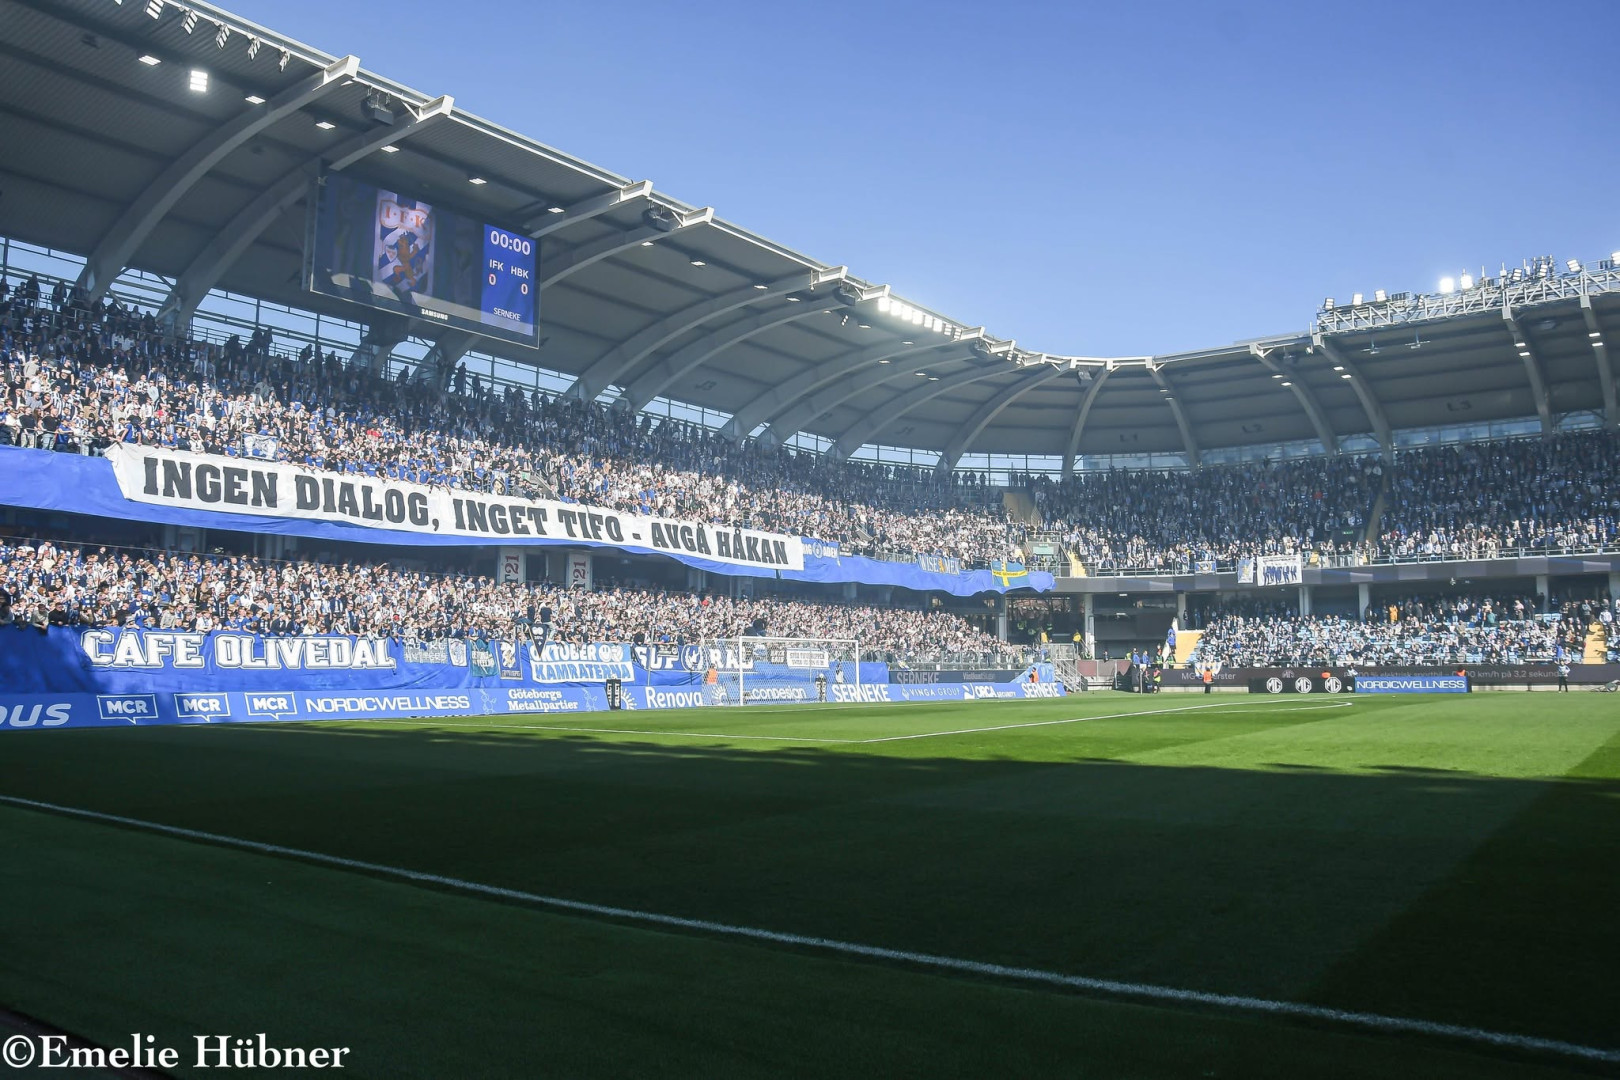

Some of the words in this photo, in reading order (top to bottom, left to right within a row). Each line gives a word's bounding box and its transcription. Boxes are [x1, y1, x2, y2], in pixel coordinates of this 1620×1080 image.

[490, 230, 531, 256] 00:00
[489, 258, 504, 272] IFK
[510, 265, 529, 280] HBK
[488, 273, 497, 286] 0
[520, 283, 529, 295] 0
[421, 308, 449, 321] SAMSUNG
[493, 306, 521, 321] SERNEKE
[143, 457, 279, 508] INGEN
[294, 473, 439, 532] DIALOG,
[452, 498, 548, 535] INGET
[558, 508, 625, 542] TIFO
[651, 522, 711, 555] AVGÅ
[716, 529, 789, 565] HÅKAN
[919, 554, 940, 573] WISE
[80, 630, 205, 669] CAFE
[215, 634, 397, 671] OLIVEDAL
[530, 643, 597, 662] OKTOBER
[535, 663, 631, 681] KAMRATERNA
[896, 671, 940, 684] SERNEKE
[1181, 672, 1195, 680] MG
[1198, 672, 1236, 681] Cerster
[1477, 670, 1500, 678] km/h
[1501, 670, 1512, 680] på
[1514, 670, 1527, 679] 3,2
[1529, 670, 1560, 678] sekund
[909, 687, 936, 697] VINGA
[937, 687, 960, 696] GROUP
[975, 685, 996, 698] ORCA
[1021, 682, 1061, 698] SERNEKE
[1267, 678, 1282, 693] MG
[1296, 678, 1311, 693] MG
[1326, 678, 1341, 693] MG
[1356, 680, 1466, 689] NORDICWELLNESS
[508, 688, 563, 702] Göteborgs
[645, 686, 704, 709] Renova
[831, 683, 892, 702] SERNEKE
[106, 699, 149, 714] MCR
[183, 698, 221, 712] MCR
[252, 697, 289, 711] MCR
[306, 695, 470, 714] NORDICWELLNESS
[508, 699, 579, 712] Metallpartier
